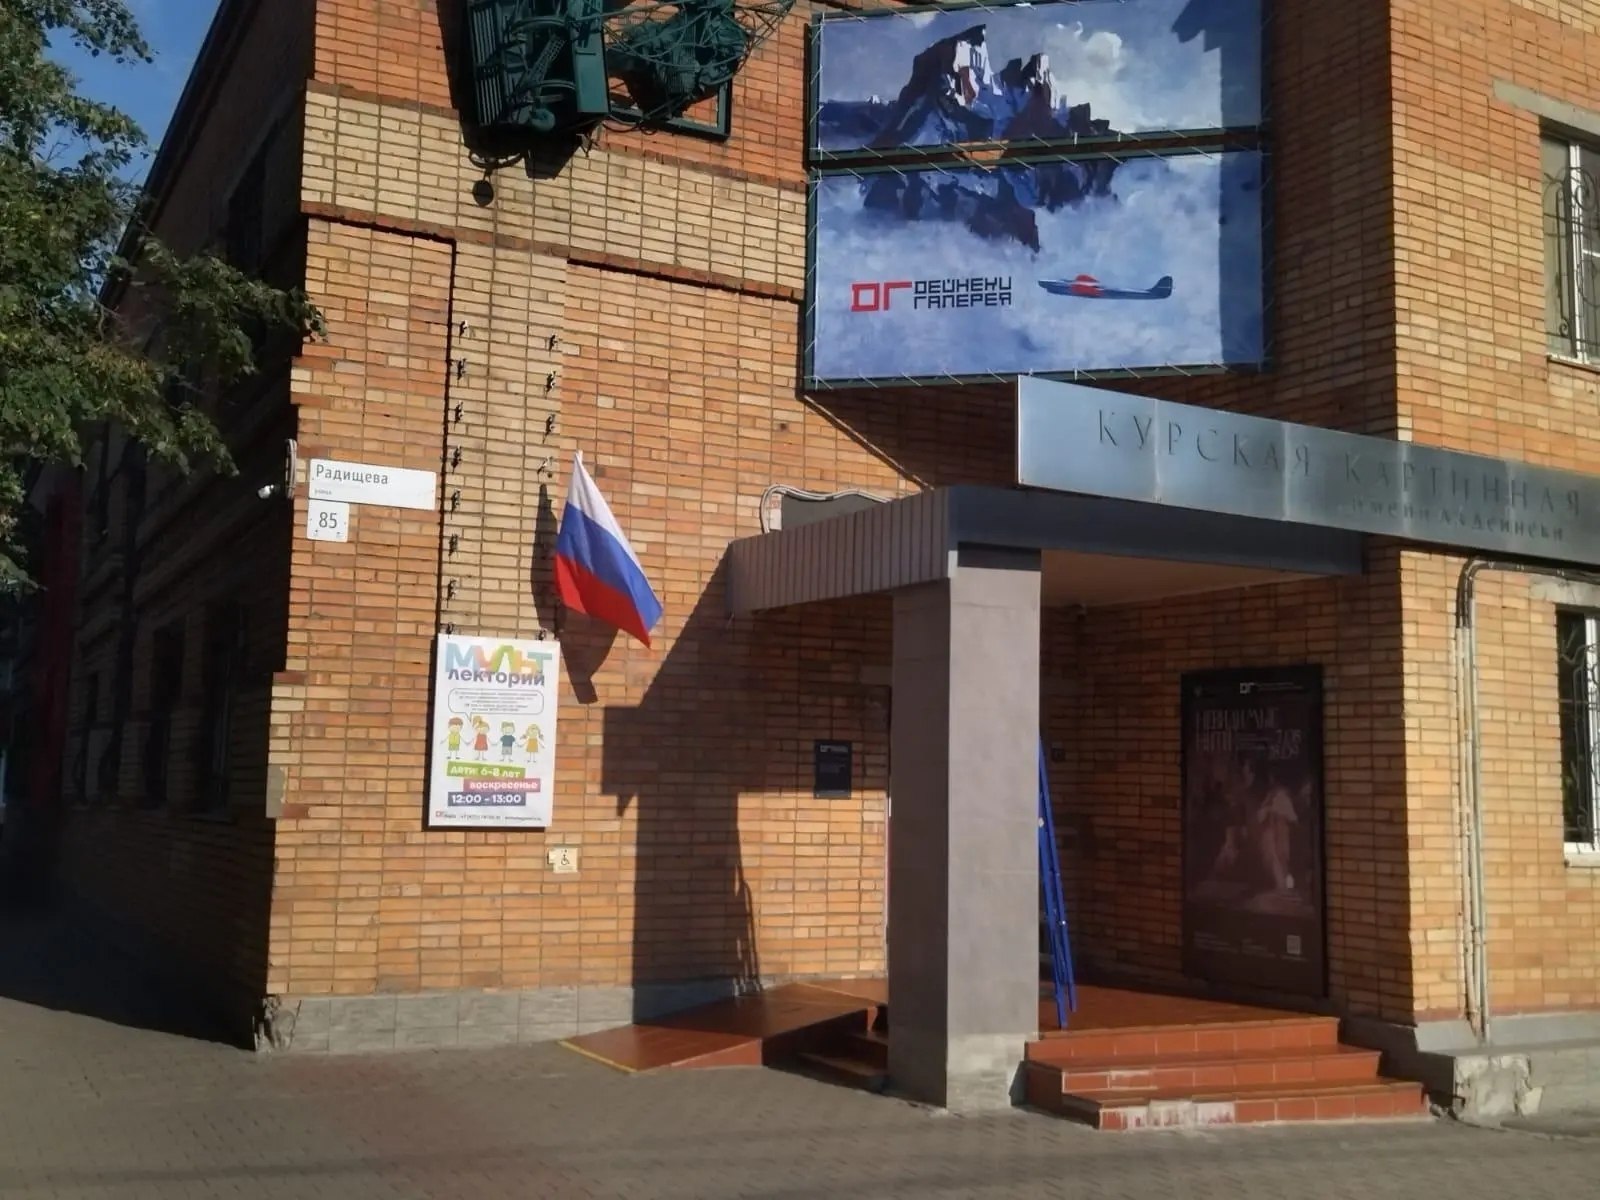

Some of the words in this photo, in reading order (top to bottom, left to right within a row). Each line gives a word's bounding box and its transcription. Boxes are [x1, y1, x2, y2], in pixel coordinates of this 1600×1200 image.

[914, 292, 1011, 309] ГАЛЕРЕЯ
[1099, 408, 1310, 476] КУРСКАЯ
[316, 464, 389, 485] Радищева
[319, 511, 337, 529] 85
[445, 642, 552, 674] МУЛЬТ
[448, 668, 545, 688] лекторий
[452, 794, 482, 804] 12:00
[492, 794, 521, 804] 13:00
